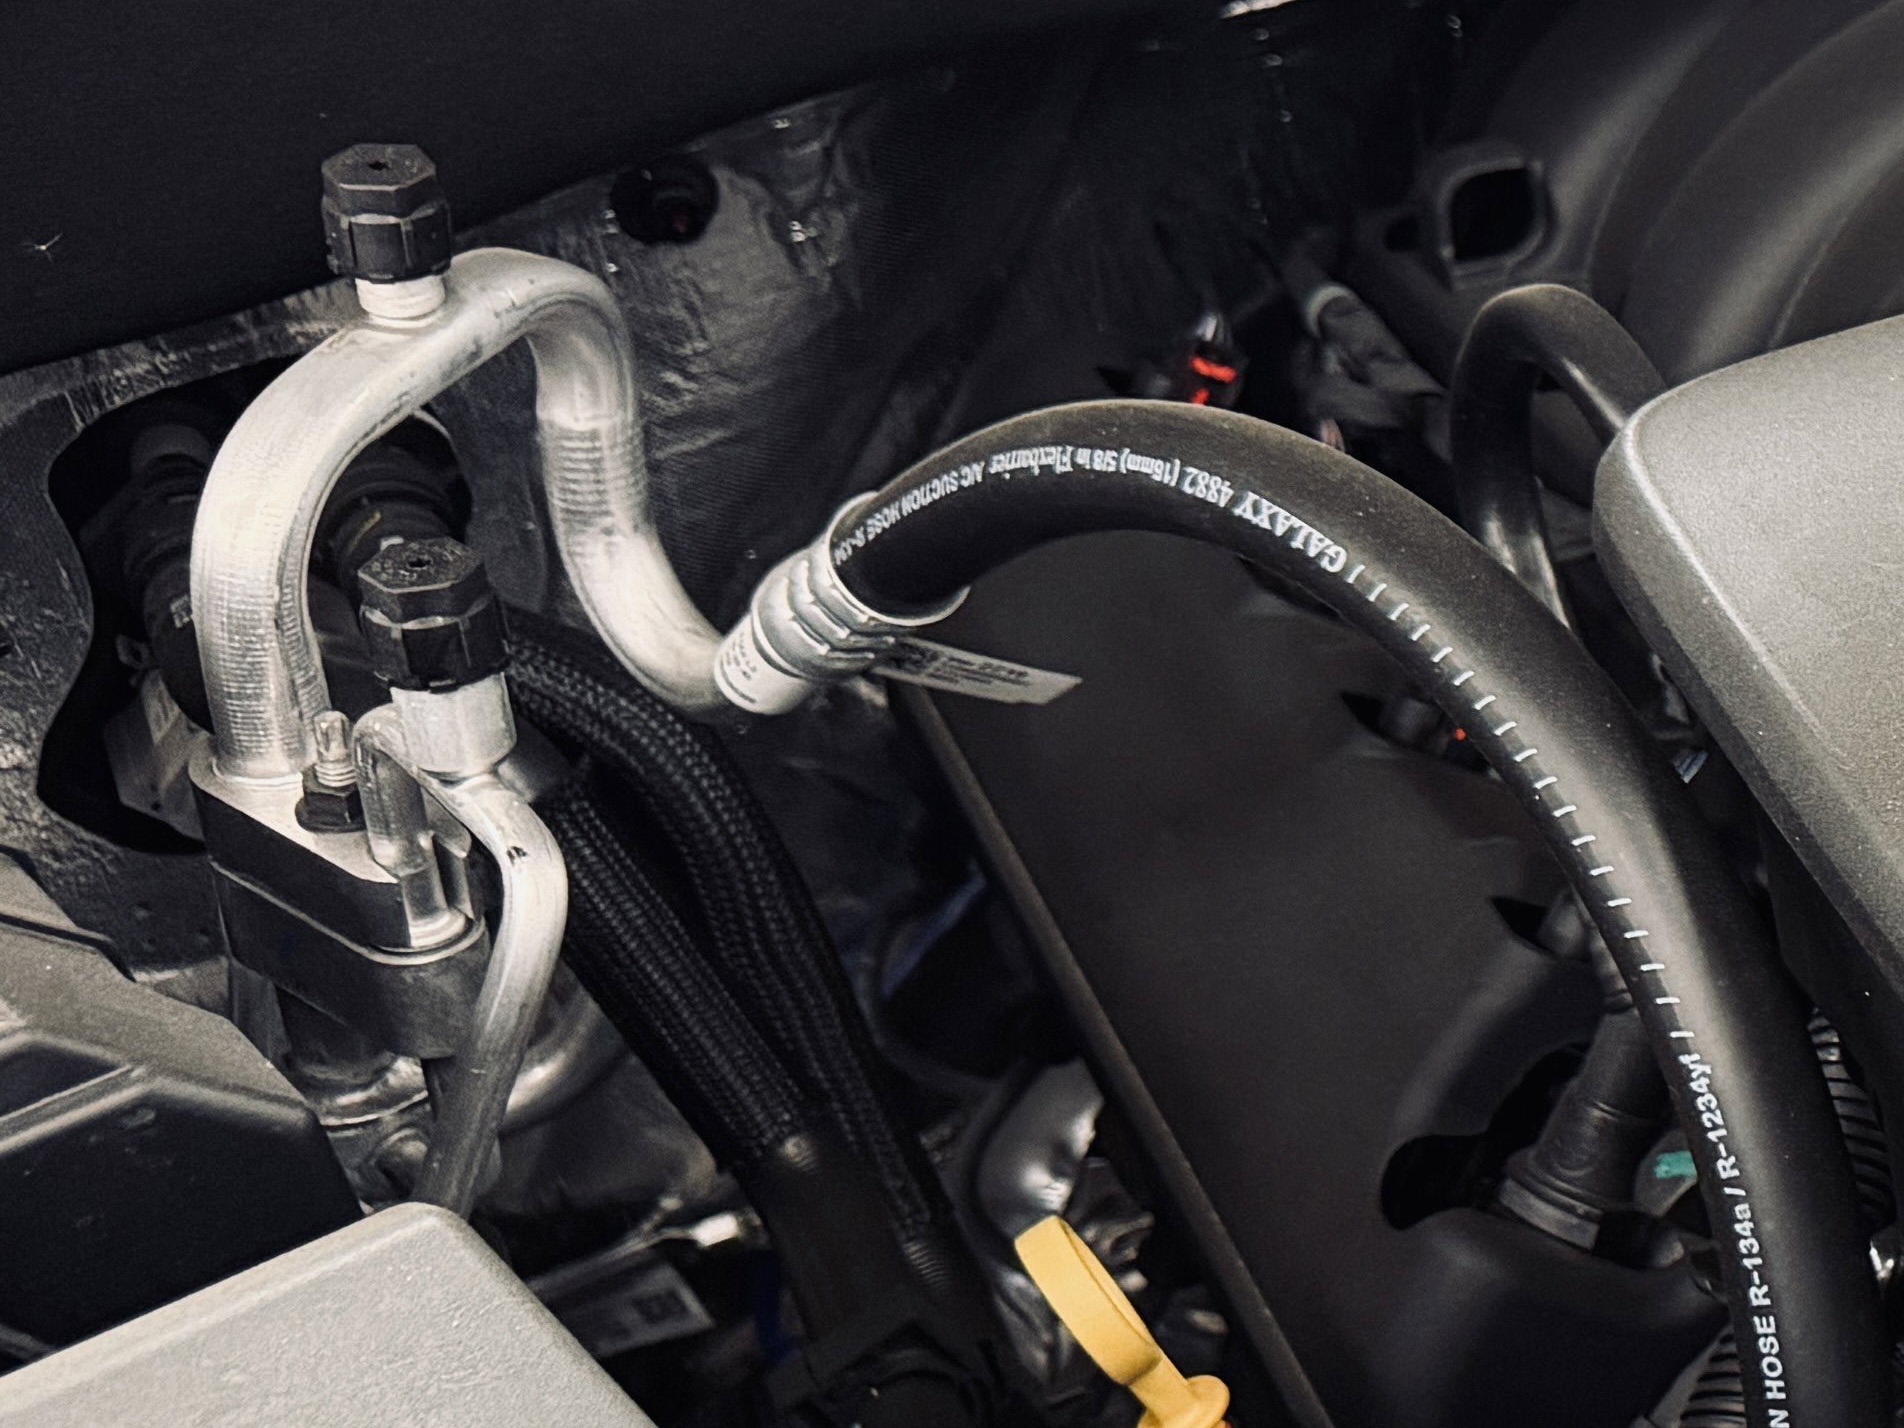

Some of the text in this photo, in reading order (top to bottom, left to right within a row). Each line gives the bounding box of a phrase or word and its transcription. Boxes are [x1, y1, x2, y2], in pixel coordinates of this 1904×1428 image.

[959, 460, 986, 489] A/C
[987, 444, 1075, 479] Flexbarrier
[1074, 447, 1092, 471] in
[1092, 448, 1119, 473] 5/8
[1118, 446, 1182, 488] (16mm)
[900, 470, 961, 517] SUCTION
[1180, 465, 1234, 508] 4882
[865, 500, 901, 541] HOSE
[1232, 490, 1348, 574] GALAXY
[1678, 1052, 1742, 1180] R-1234yf
[1731, 1201, 1773, 1307] R-134a
[1753, 1314, 1788, 1401] HOSE
